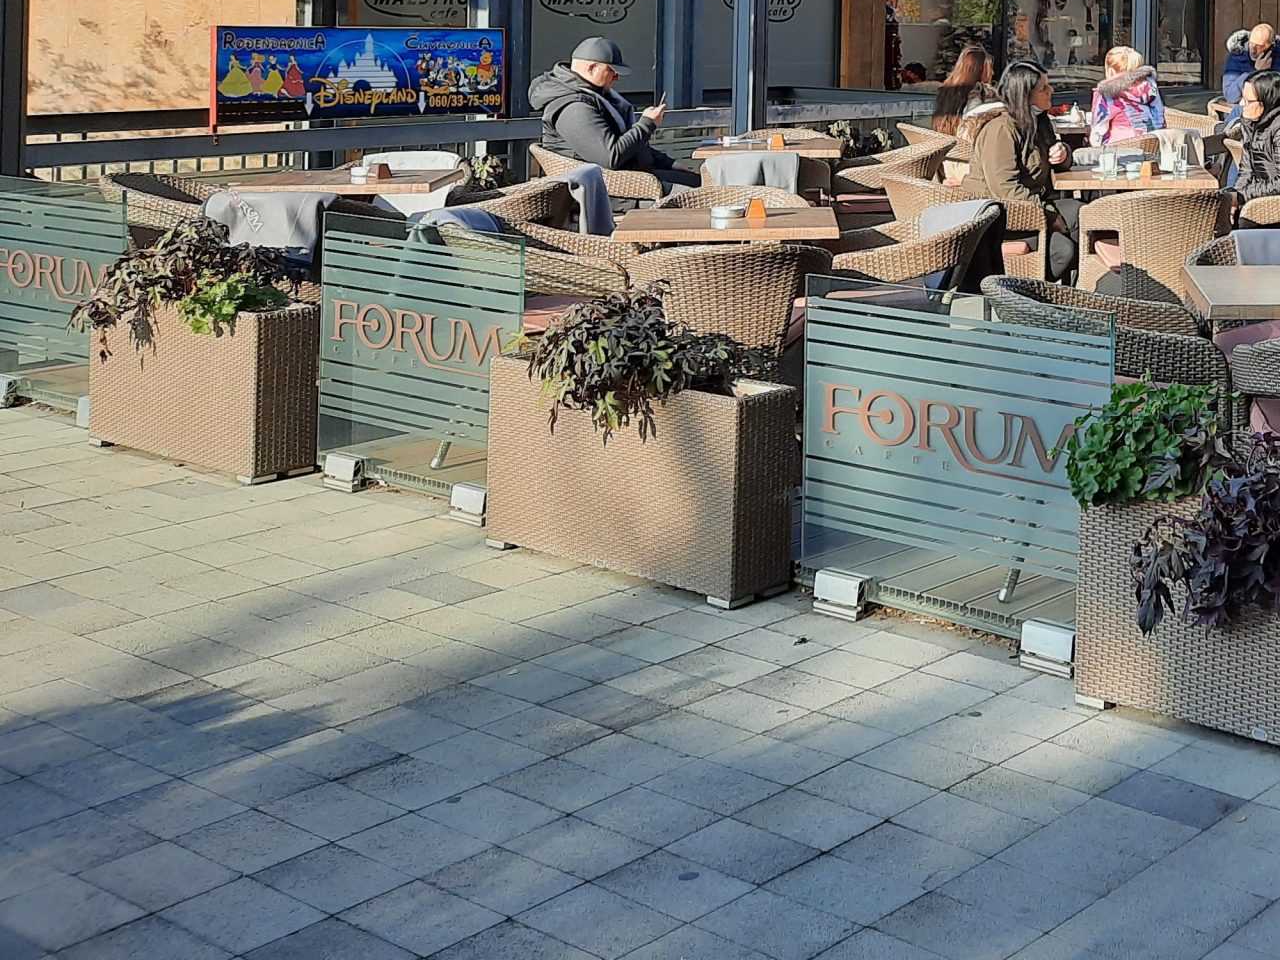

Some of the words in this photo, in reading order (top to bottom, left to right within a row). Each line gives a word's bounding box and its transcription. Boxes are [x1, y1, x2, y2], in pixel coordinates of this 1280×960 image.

[429, 94, 501, 107] 060/33-75-999
[331, 299, 503, 378] FORUM
[820, 381, 1078, 489] FORUM
